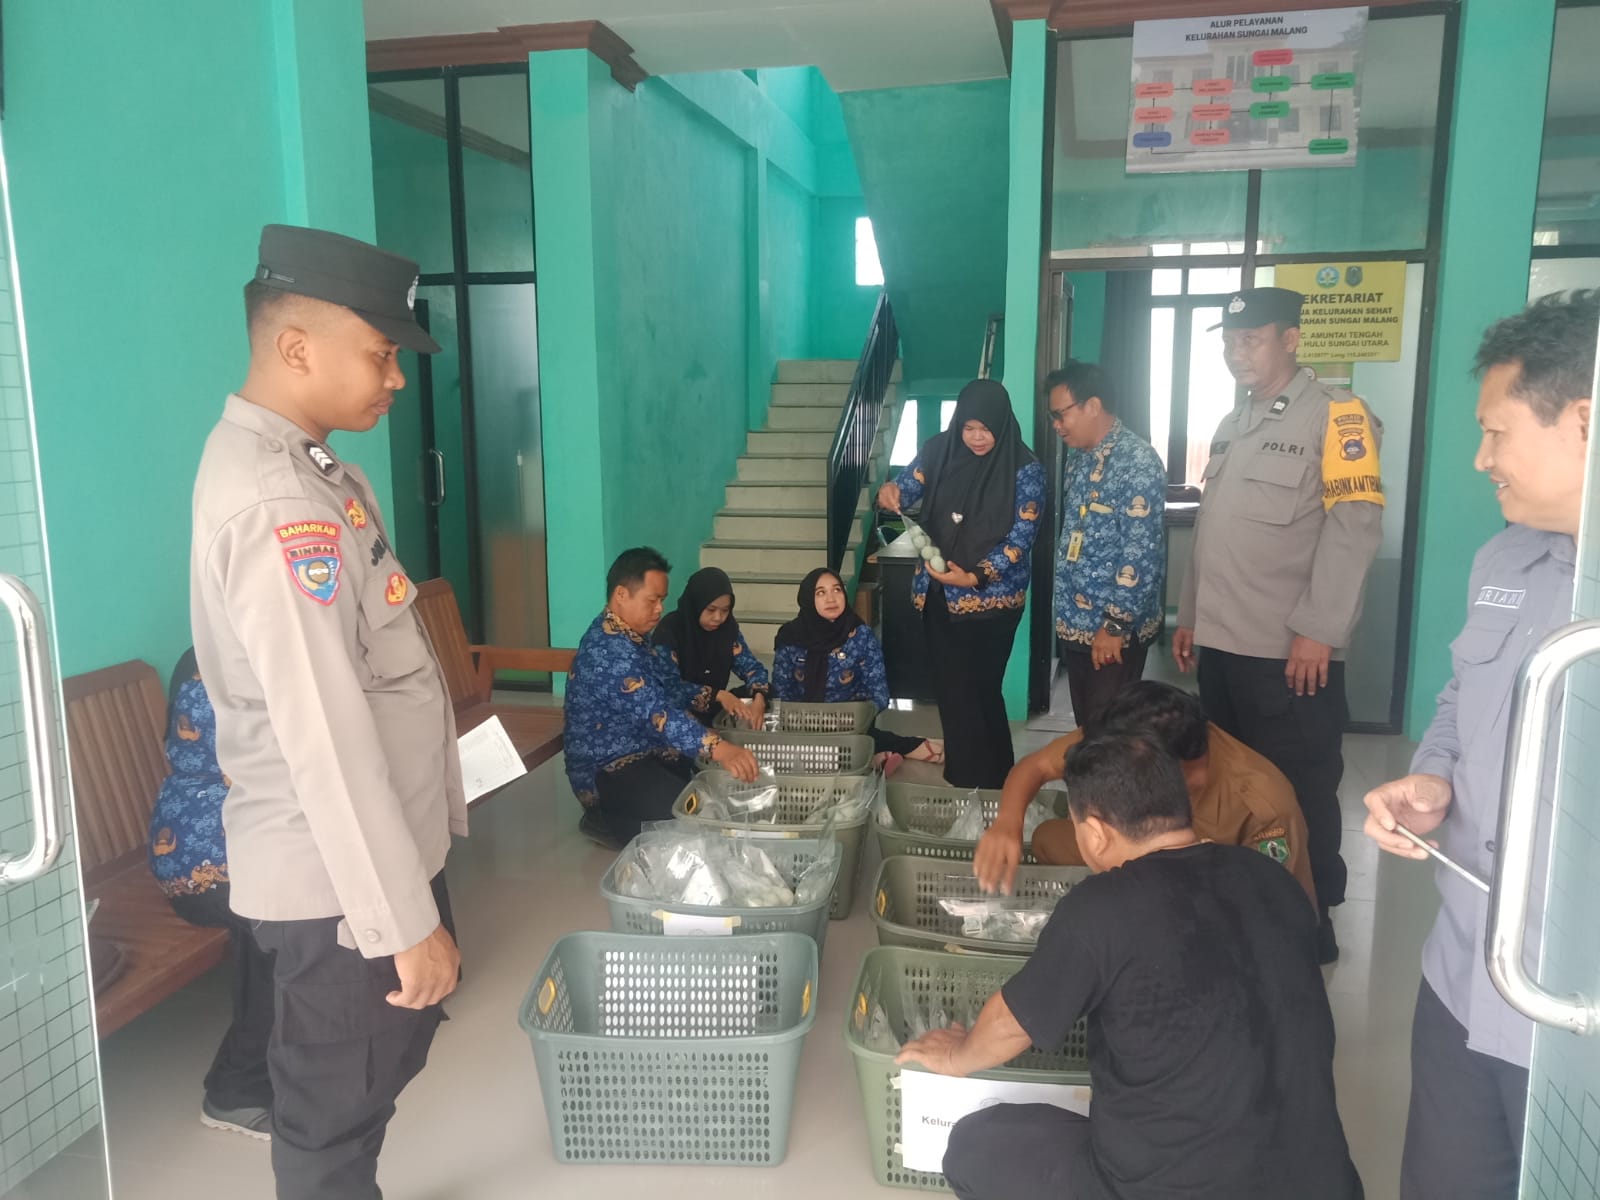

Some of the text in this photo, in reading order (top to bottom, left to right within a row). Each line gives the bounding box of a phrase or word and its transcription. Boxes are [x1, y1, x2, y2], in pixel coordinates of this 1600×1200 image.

[1210, 17, 1284, 29] ALUR PELAYANAN
[1185, 26, 1308, 41] KELURAHAN SUNGAI MALANG
[1303, 293, 1384, 305] EKRETARIAT
[1312, 307, 1364, 316] KELURAHAN
[1365, 307, 1393, 315] SEHAT
[1328, 317, 1361, 325] SUNGAI
[1363, 316, 1399, 324] MALANG
[1310, 331, 1347, 339] AMUNTAI
[1349, 331, 1383, 339] TENGAH
[1303, 340, 1327, 348] HULU
[1361, 339, 1389, 347] UTARA
[1262, 441, 1305, 456] POLRI
